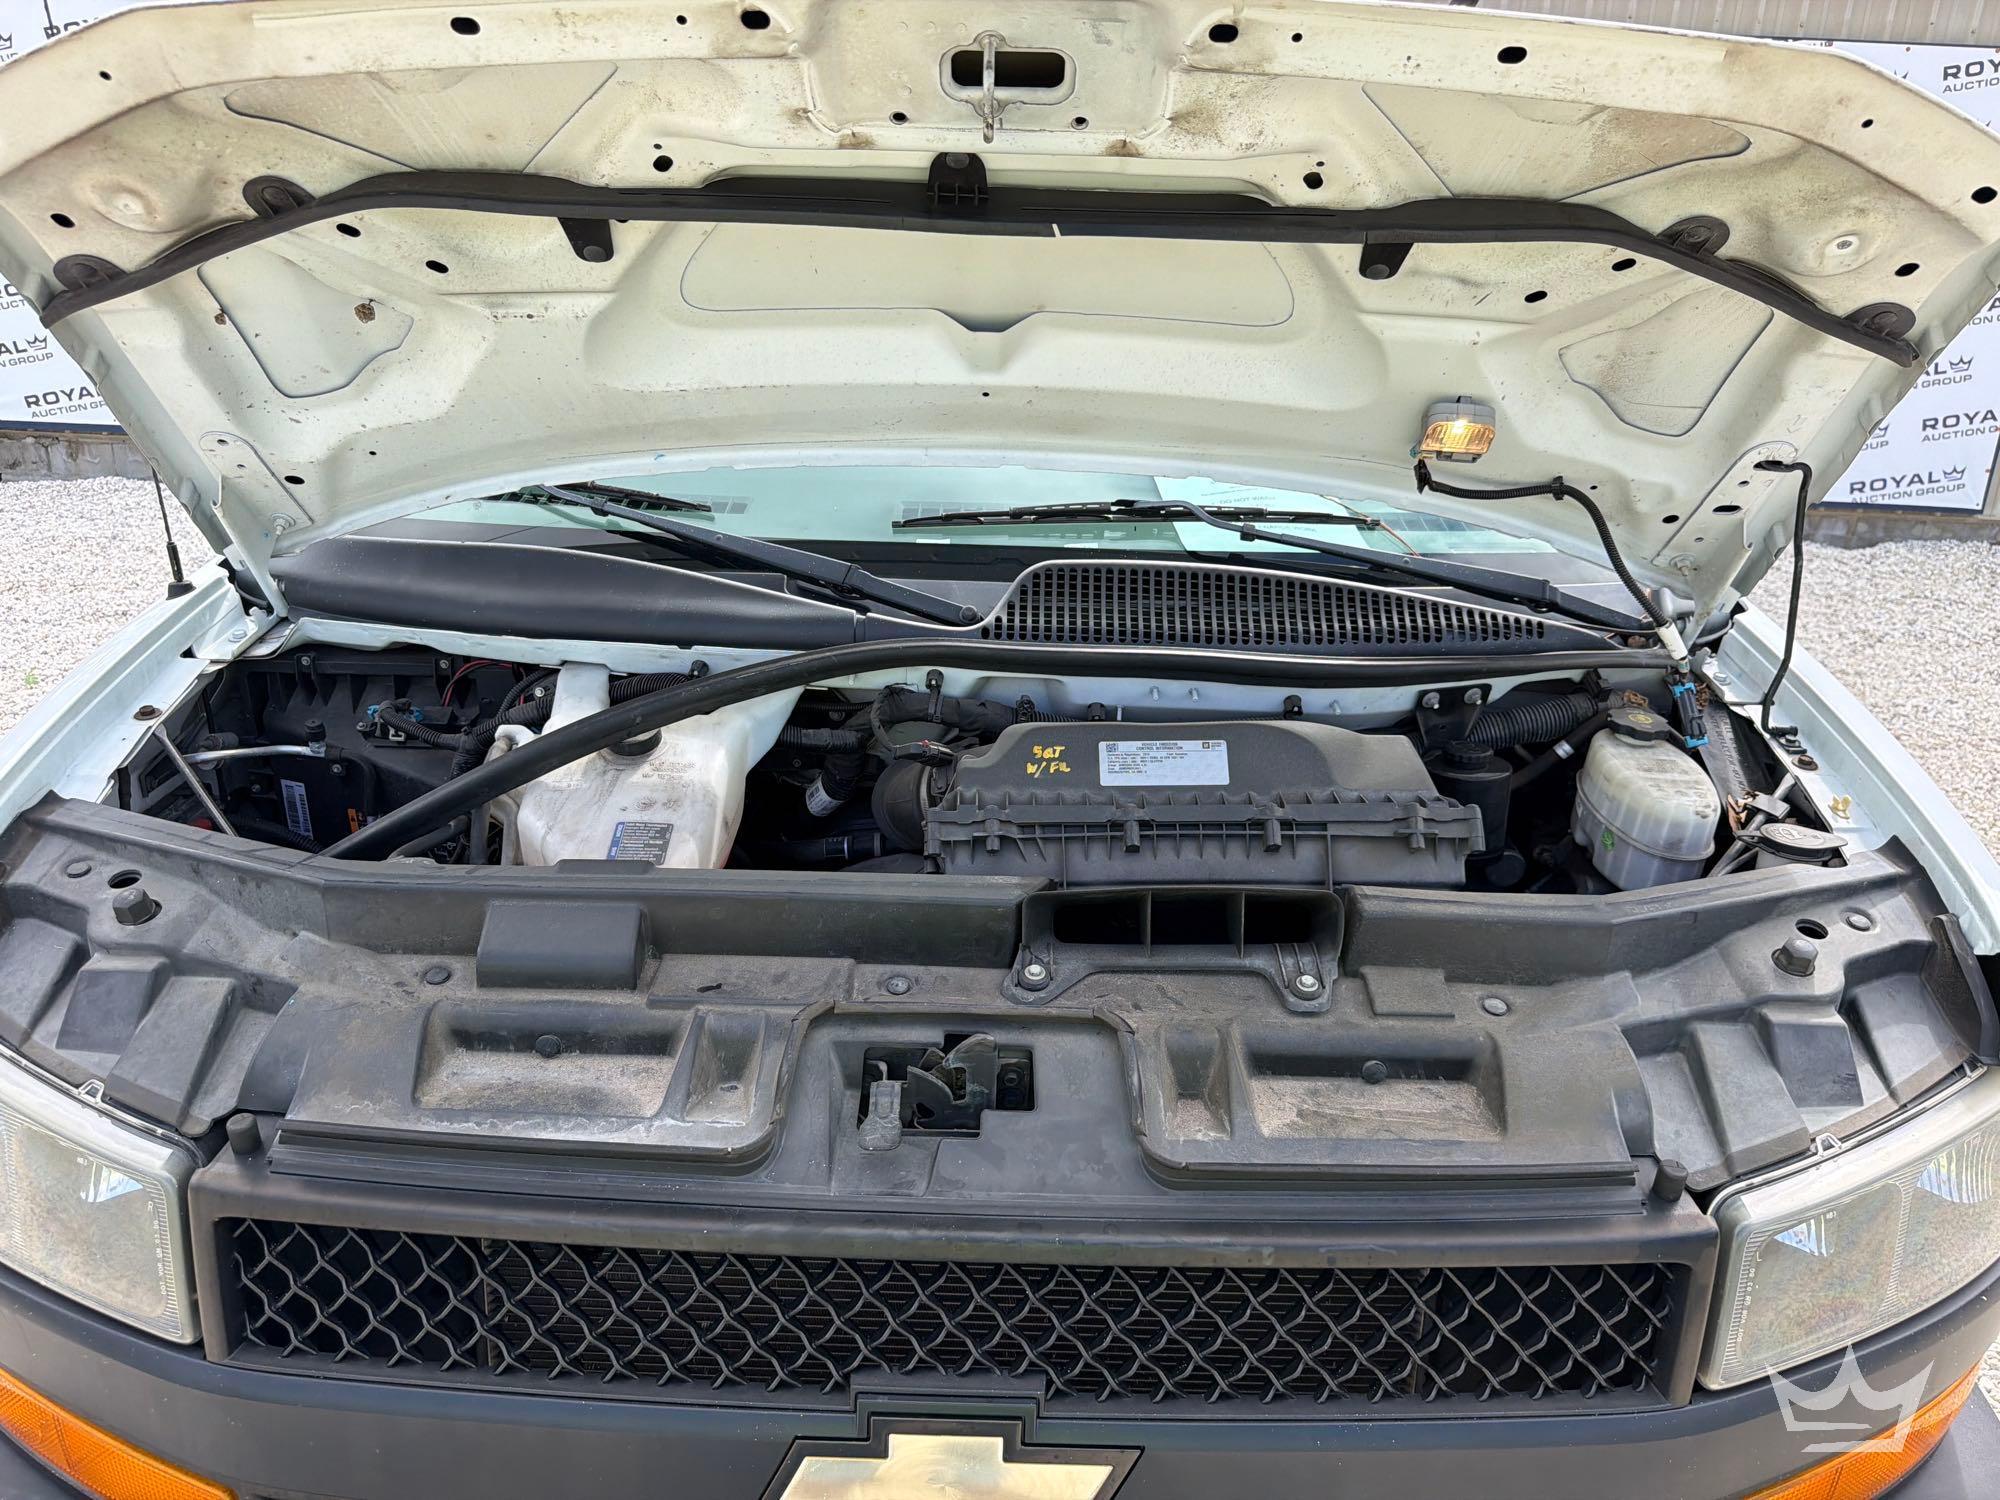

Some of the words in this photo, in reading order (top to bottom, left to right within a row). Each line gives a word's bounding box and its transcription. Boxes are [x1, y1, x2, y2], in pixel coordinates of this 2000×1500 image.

[1942, 58, 2000, 81] ROY
[1943, 77, 2000, 94] AUCTIO
[8, 352, 54, 367] GROUP
[1921, 374, 1973, 389] GROUP
[24, 386, 101, 408] ROYA
[31, 402, 88, 419] AUCTION
[1921, 409, 1999, 432] ROYA
[1921, 425, 1986, 443] AUCTION
[1849, 471, 1941, 495] ROYAL
[1851, 489, 1913, 504] AUCTION
[1915, 482, 1966, 496] GROUP
